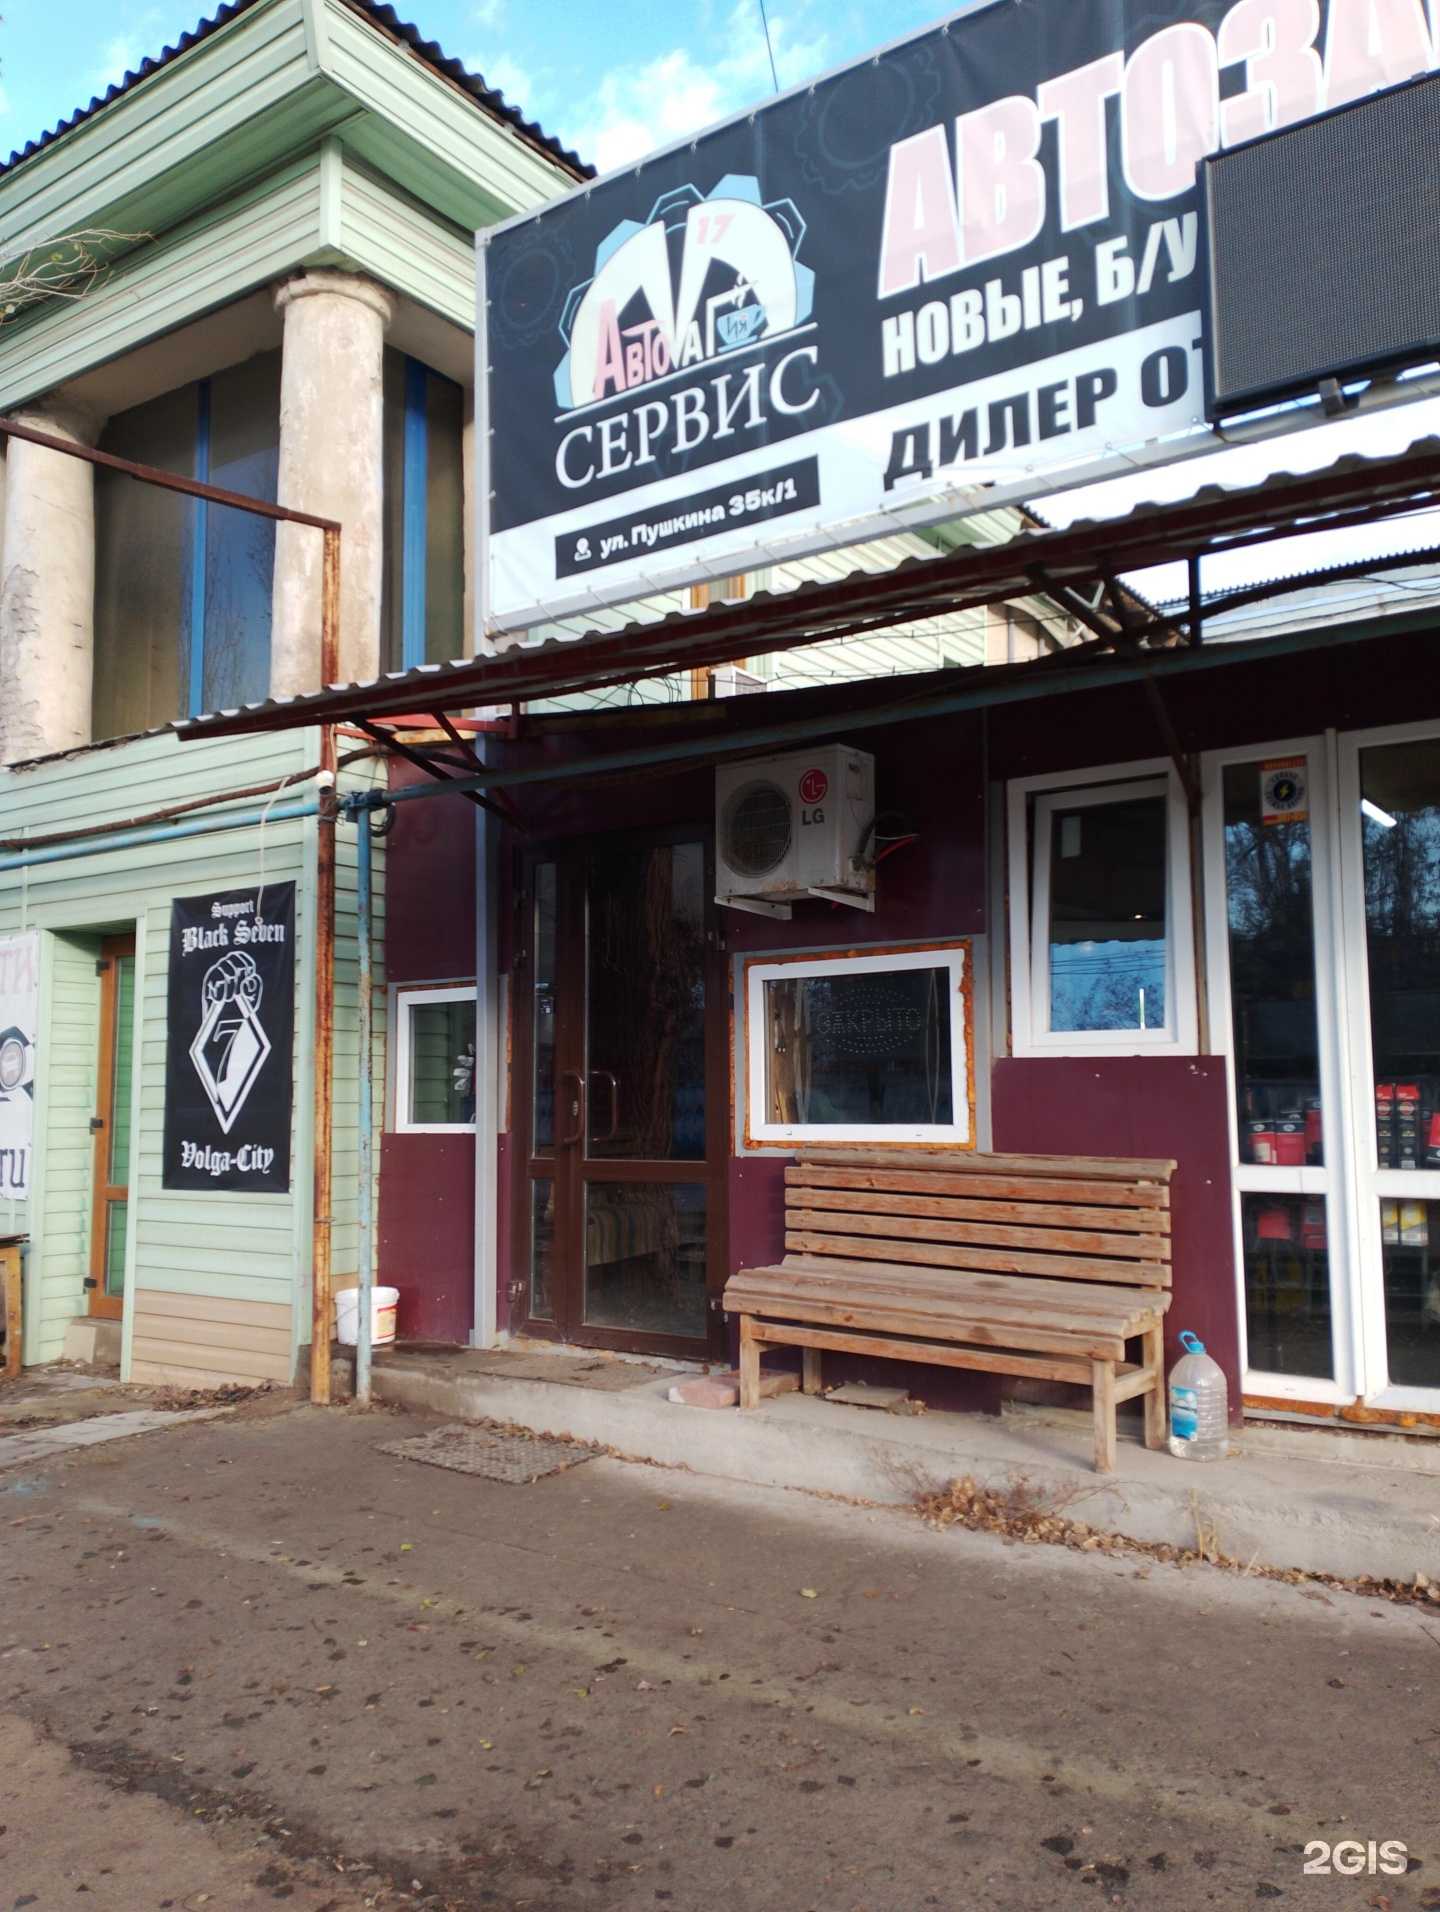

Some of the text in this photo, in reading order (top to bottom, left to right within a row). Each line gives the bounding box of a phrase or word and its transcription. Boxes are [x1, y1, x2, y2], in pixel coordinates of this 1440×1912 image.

[881, 210, 1199, 378] НОВЫЕ, Б/У
[554, 345, 820, 488] СЕРВИС
[882, 335, 1203, 492] ДИЛЕР О
[599, 477, 798, 559] ул. Пушкина 35к/1
[802, 808, 825, 825] LG
[181, 920, 285, 957] Black Seven
[211, 899, 255, 919] Support
[181, 1140, 274, 1177] Volga-City
